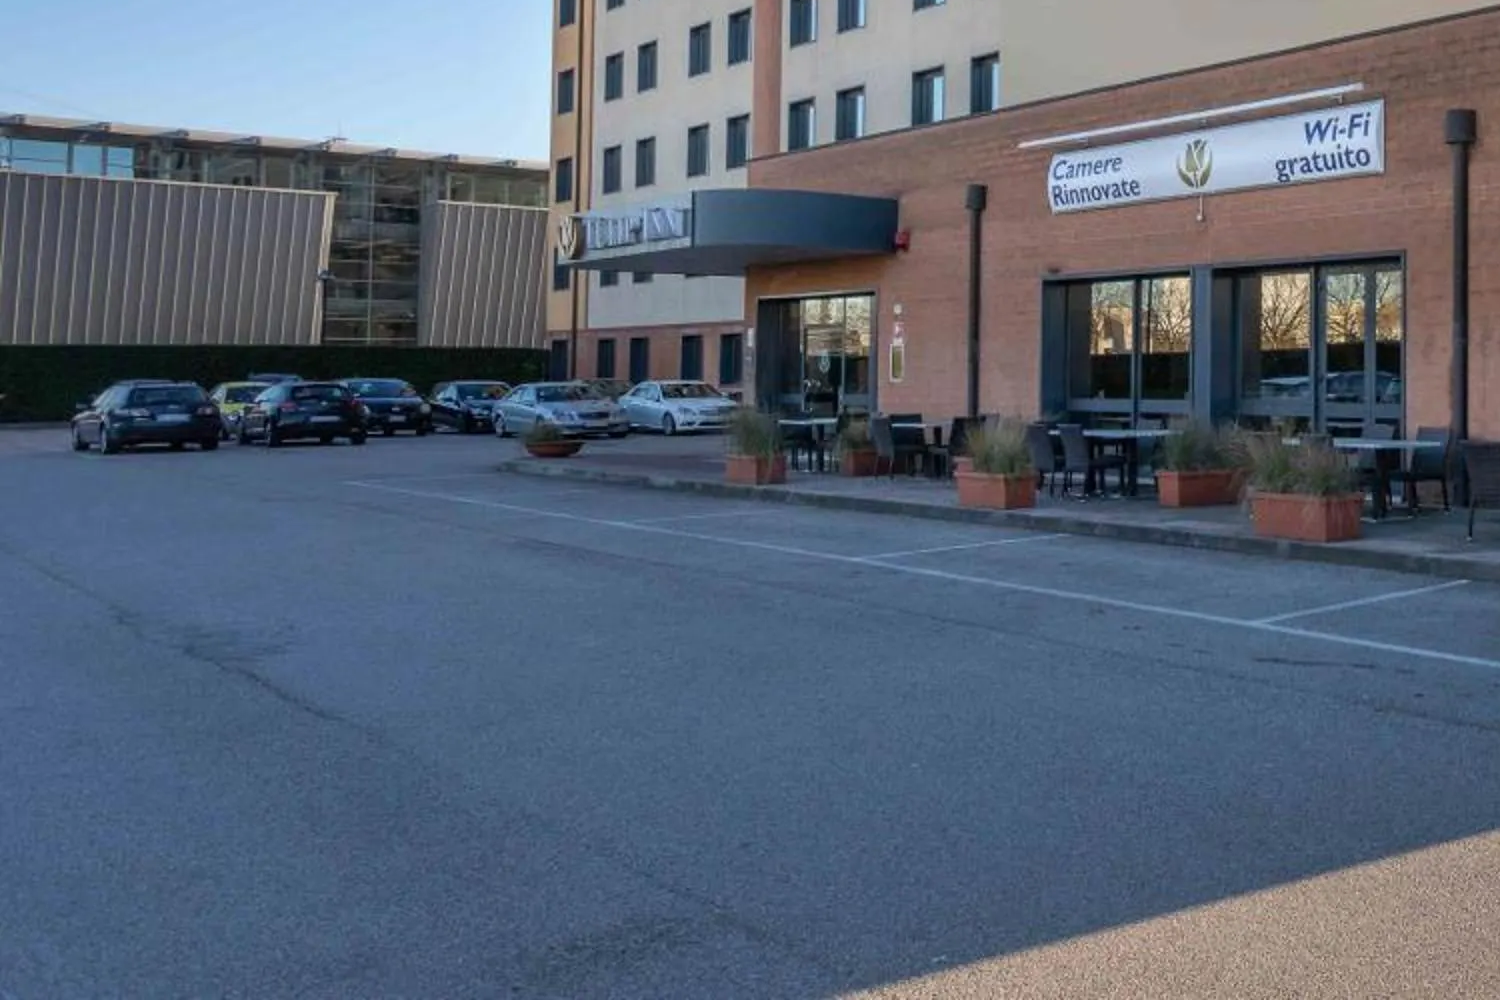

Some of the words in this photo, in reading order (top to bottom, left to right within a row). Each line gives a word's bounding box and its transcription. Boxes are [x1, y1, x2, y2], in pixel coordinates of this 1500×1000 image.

[1304, 112, 1370, 147] Wi-Fi
[1052, 155, 1123, 181] Camere
[1275, 144, 1371, 184] gratuito
[1052, 178, 1141, 208] Rinnovate
